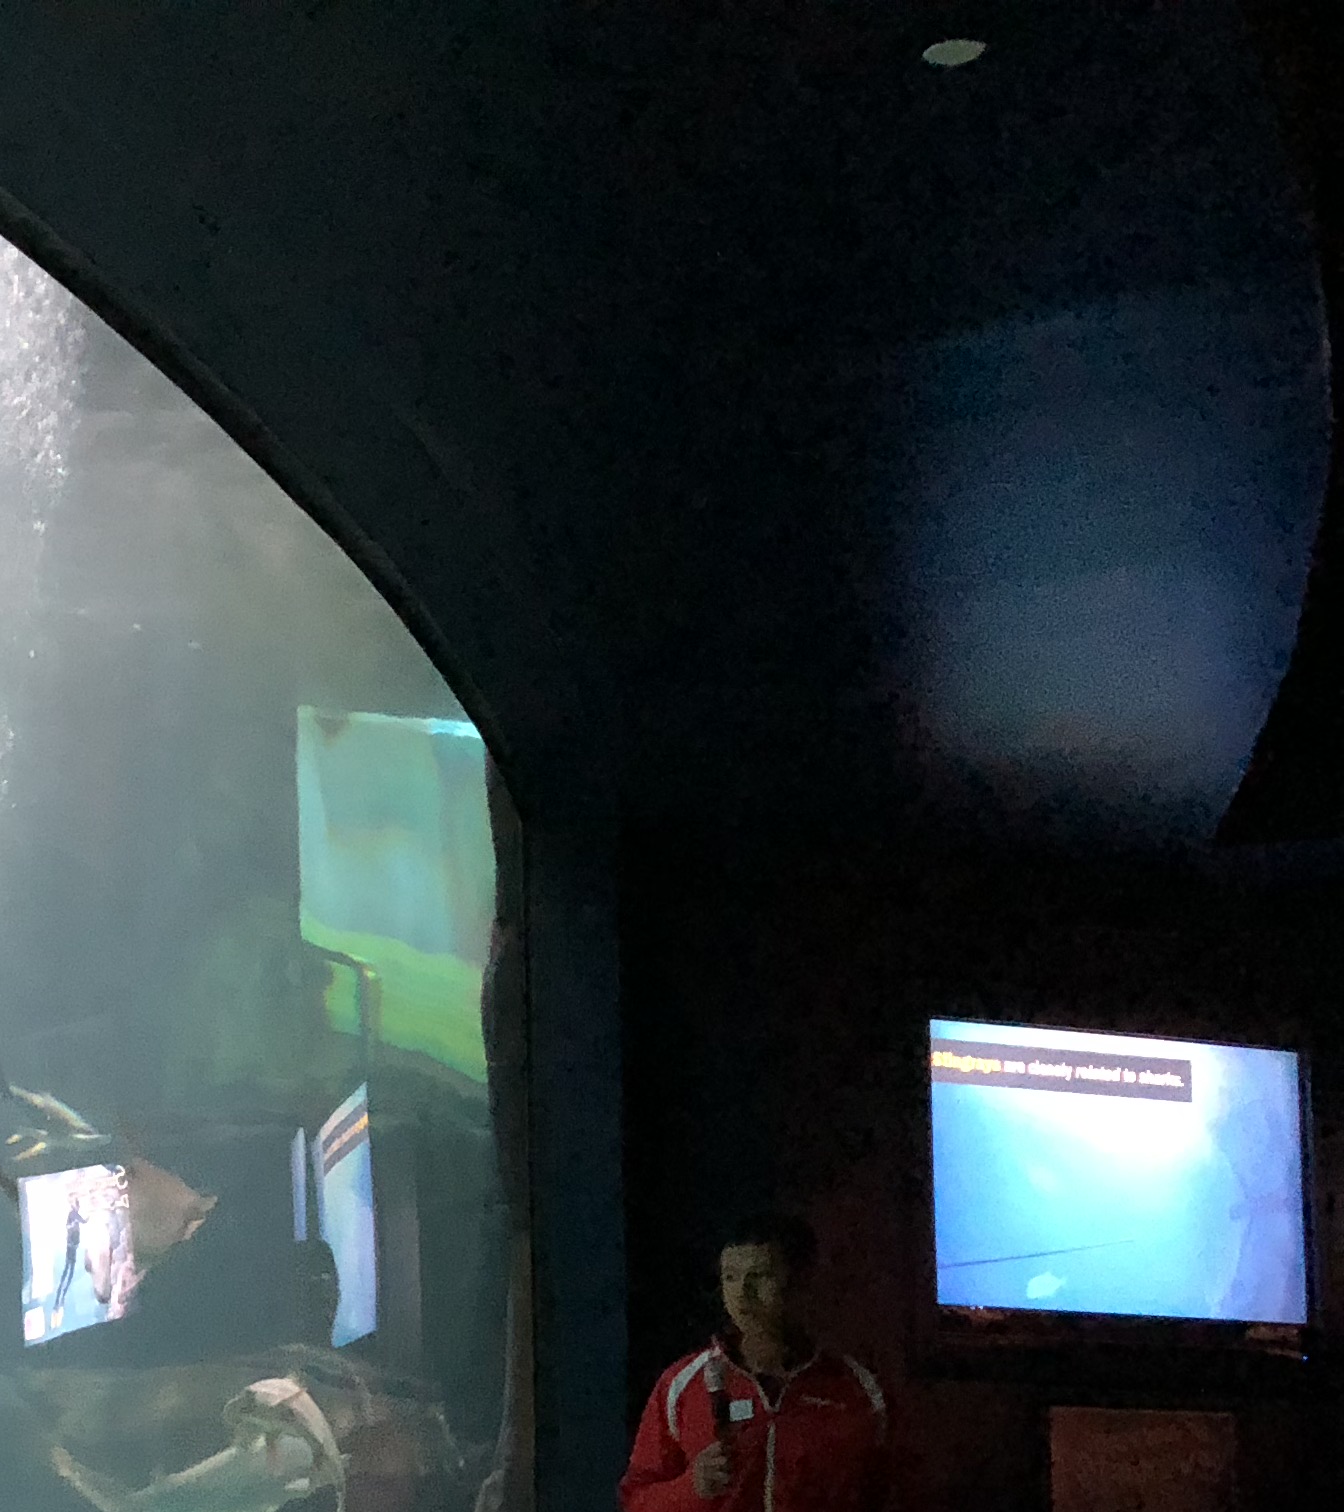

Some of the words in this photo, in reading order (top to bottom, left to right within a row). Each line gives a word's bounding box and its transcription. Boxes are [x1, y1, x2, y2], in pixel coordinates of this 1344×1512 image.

[932, 1051, 1000, 1072] Stingrays
[1003, 1061, 1025, 1073] are
[1028, 1060, 1072, 1081] closely
[1075, 1065, 1121, 1081] related
[1124, 1068, 1136, 1082] to
